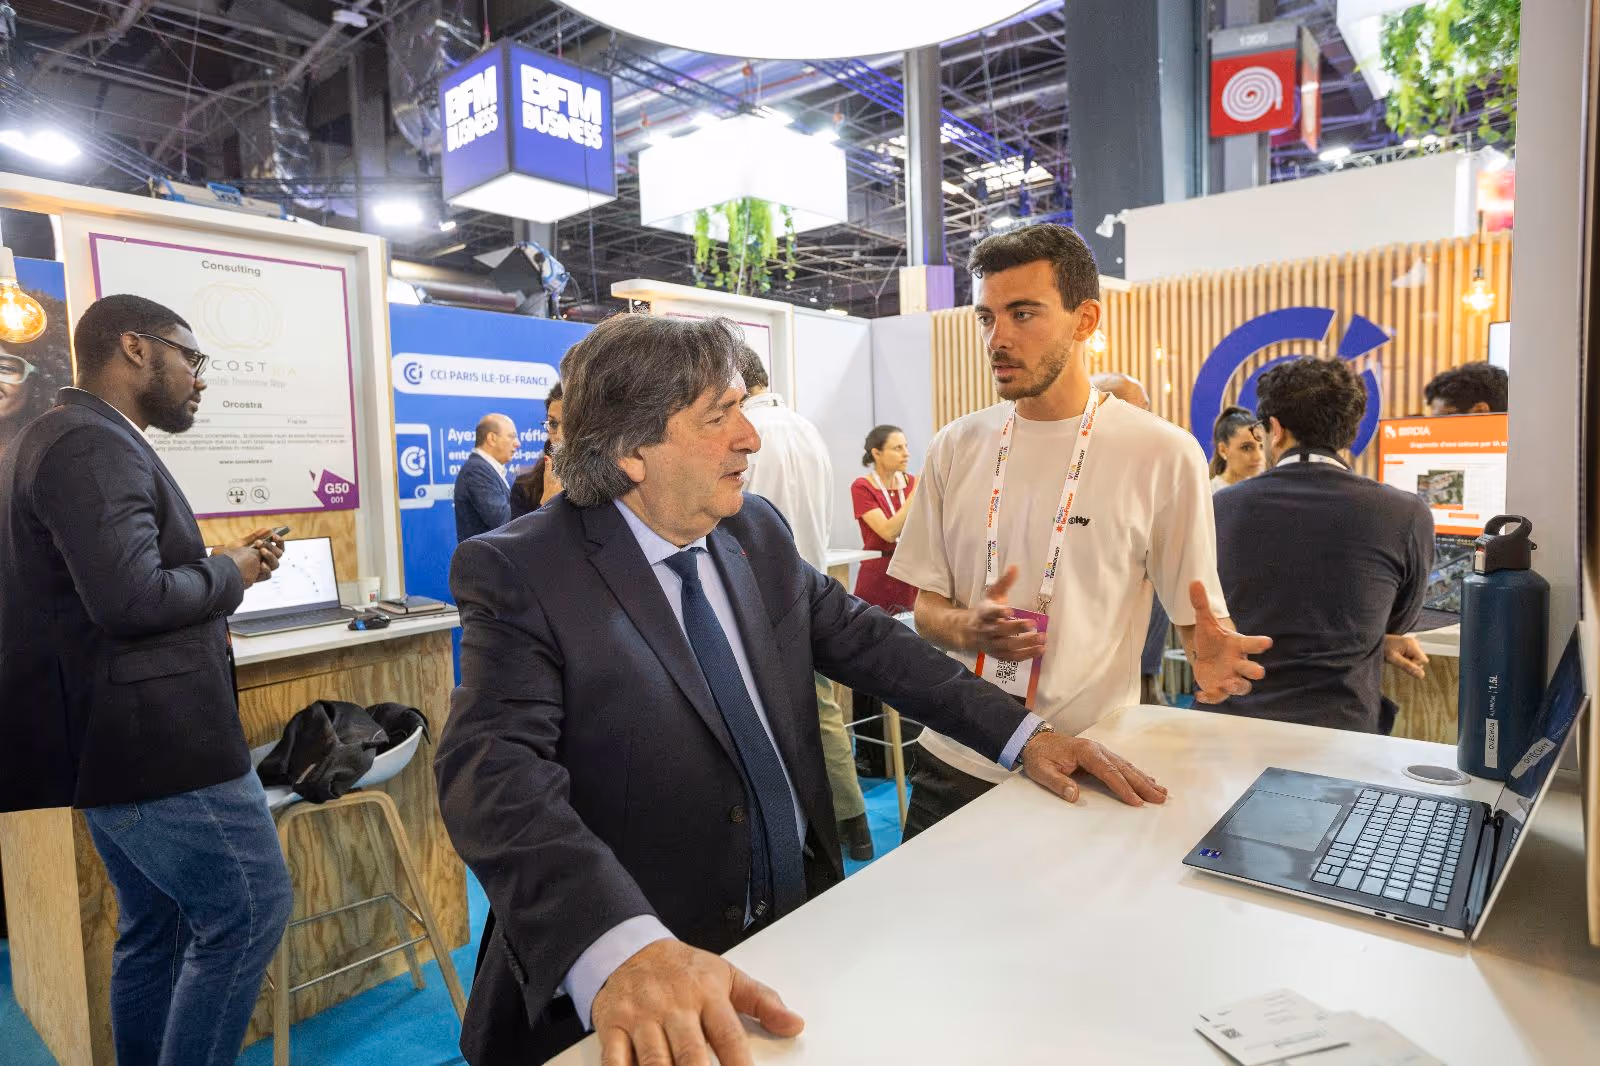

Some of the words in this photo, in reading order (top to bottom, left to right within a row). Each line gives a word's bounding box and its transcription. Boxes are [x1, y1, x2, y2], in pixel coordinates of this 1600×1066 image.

[445, 65, 498, 128] BFM
[520, 63, 602, 125] BFM
[446, 103, 499, 153] BUSINESS
[522, 101, 603, 150] BUSINESS
[201, 260, 262, 278] Consulting
[430, 369, 447, 380] CCI
[449, 370, 479, 382] PARIS
[222, 400, 263, 409] Orcostra
[324, 482, 350, 495] G50
[330, 496, 344, 504] 001
[1488, 674, 1498, 690] 1.5L
